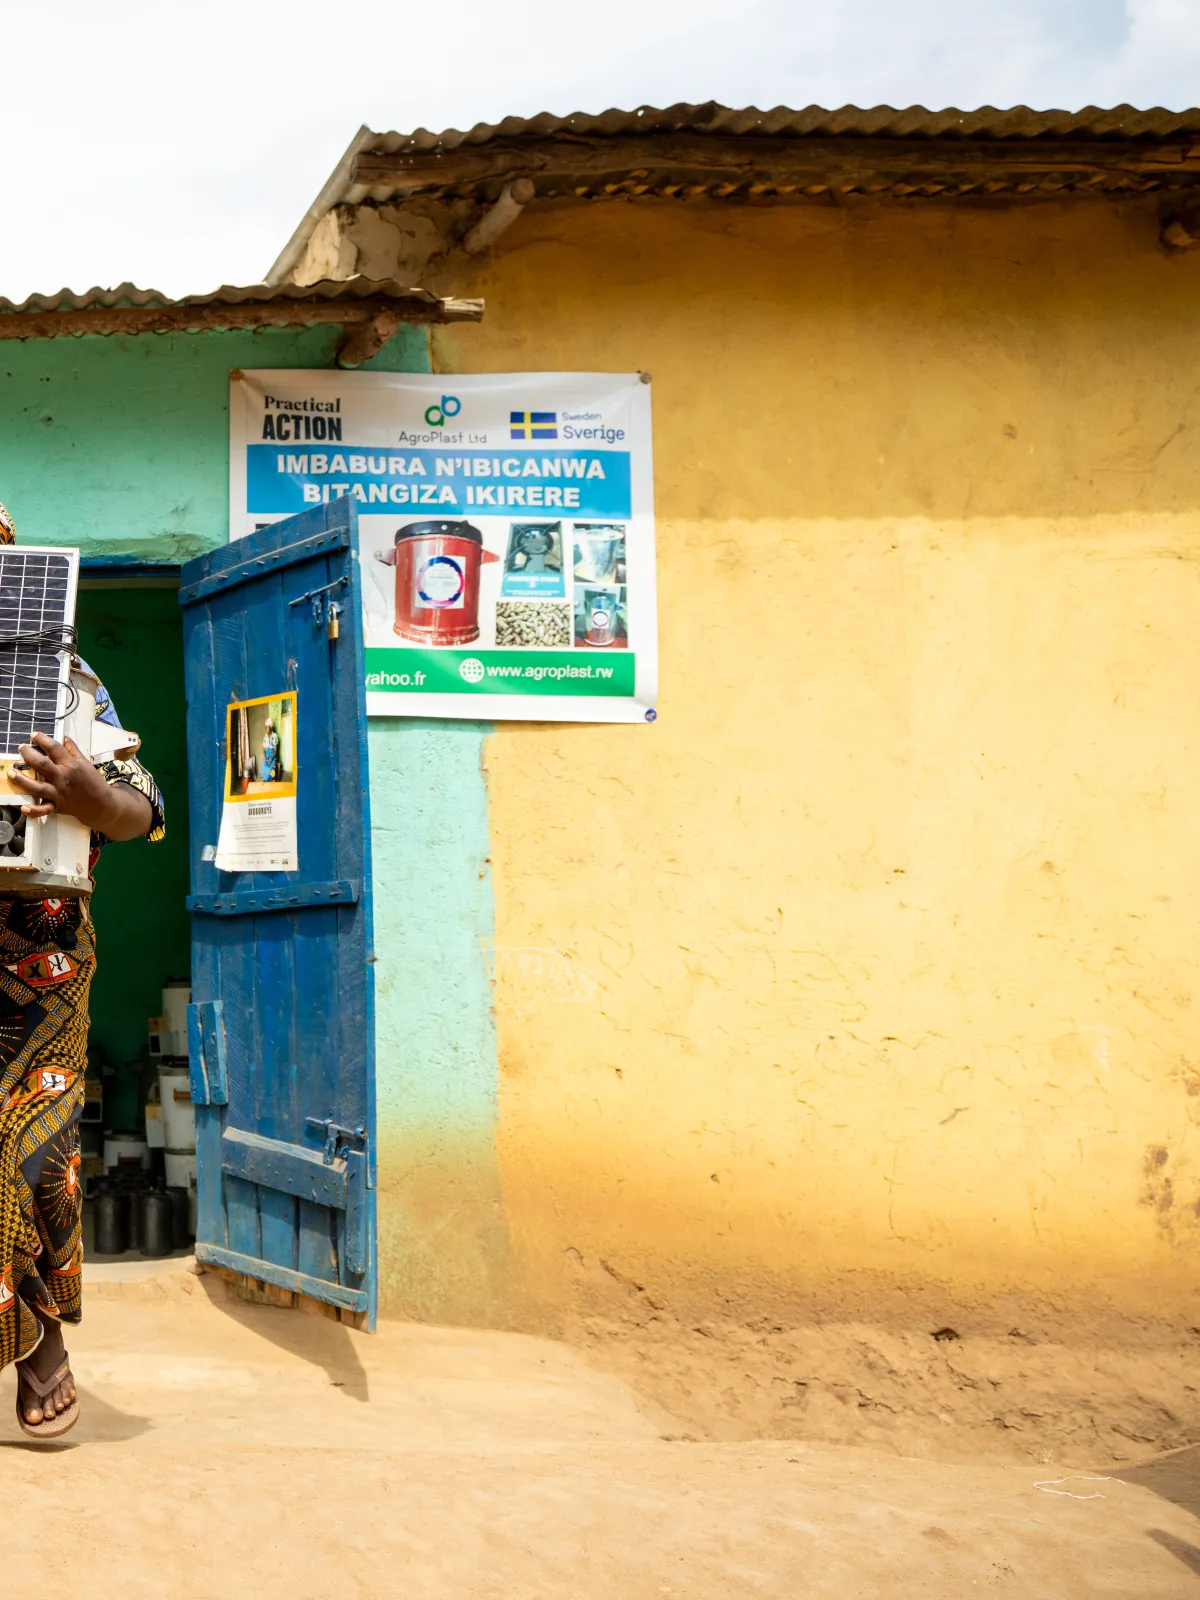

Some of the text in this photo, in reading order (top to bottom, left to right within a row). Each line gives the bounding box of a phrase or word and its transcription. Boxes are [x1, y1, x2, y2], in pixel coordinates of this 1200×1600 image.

[264, 395, 341, 413] Practical
[562, 412, 603, 421] Sweden
[262, 413, 343, 442] ACTION
[563, 424, 626, 444] Sverige
[398, 430, 488, 446] AgroPlast Ltd
[277, 453, 607, 480] IMBABURA N’IBICANWA
[303, 483, 582, 508] BITANGIZA IKIRERE
[486, 664, 615, 681] www.agroplast.rw
